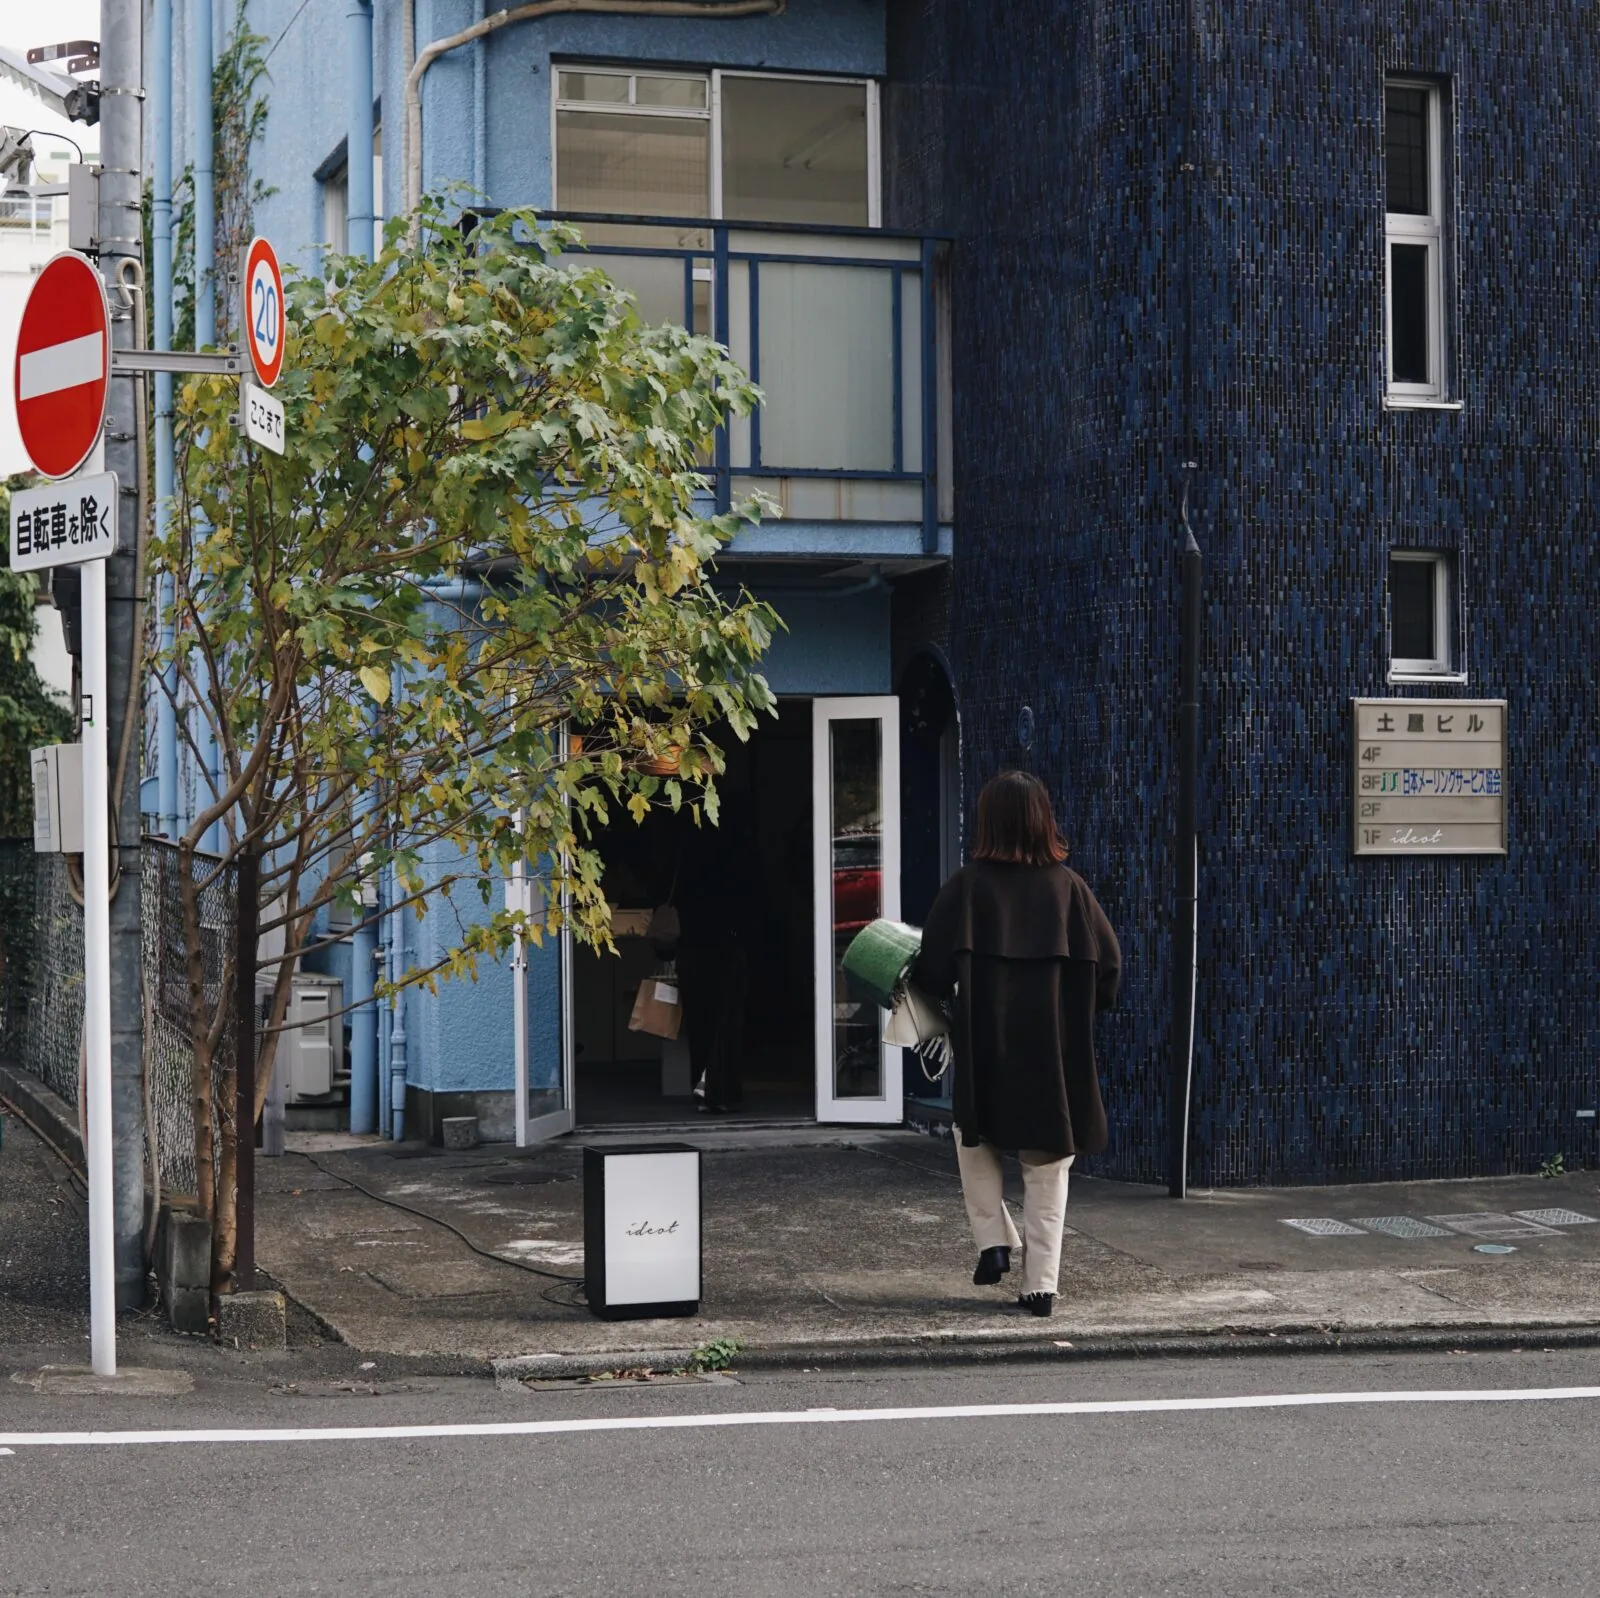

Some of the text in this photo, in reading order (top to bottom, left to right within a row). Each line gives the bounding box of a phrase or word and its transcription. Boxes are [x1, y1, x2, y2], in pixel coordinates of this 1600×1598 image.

[255, 278, 276, 347] 20
[251, 399, 281, 439] ここまで
[17, 494, 109, 556] 自転車を除く
[1361, 746, 1382, 763] 4F
[1361, 774, 1381, 790] 3F
[1361, 802, 1381, 818] 2F
[1363, 829, 1381, 845] 1F
